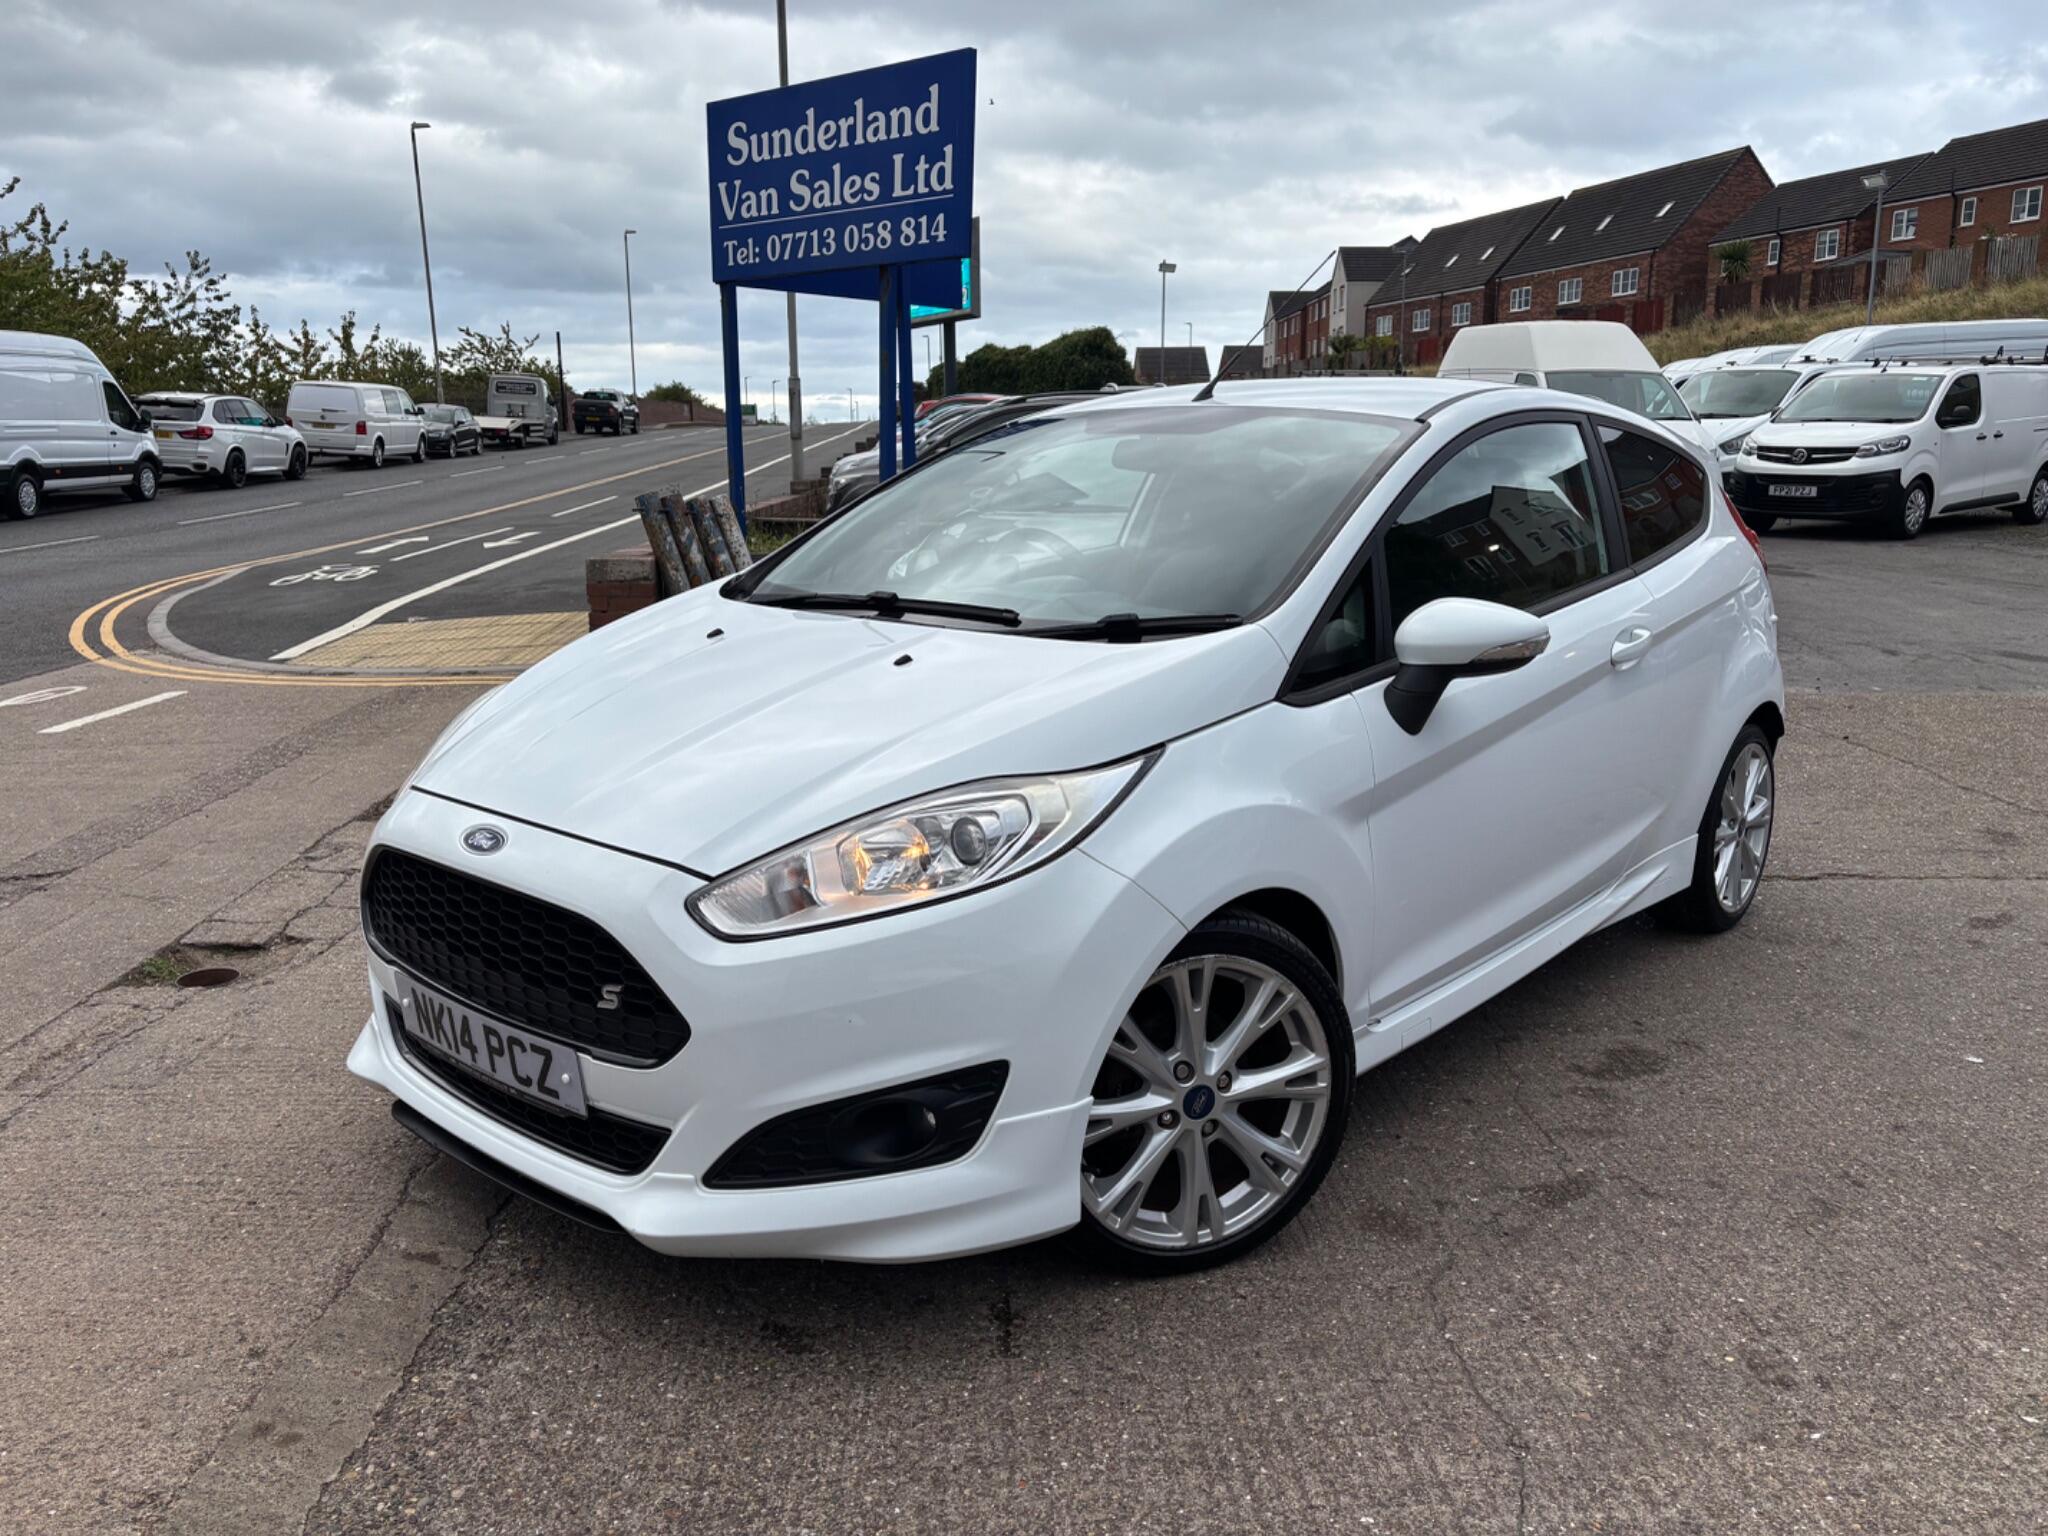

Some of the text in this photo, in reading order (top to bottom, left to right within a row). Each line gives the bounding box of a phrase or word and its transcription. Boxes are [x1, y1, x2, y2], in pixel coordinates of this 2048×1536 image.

[726, 82, 940, 166] Sunderland
[717, 143, 954, 221] Van Sales Ltd
[723, 212, 948, 267] Tel: 07713 058 814
[411, 986, 560, 1100] NK14 PCZ
